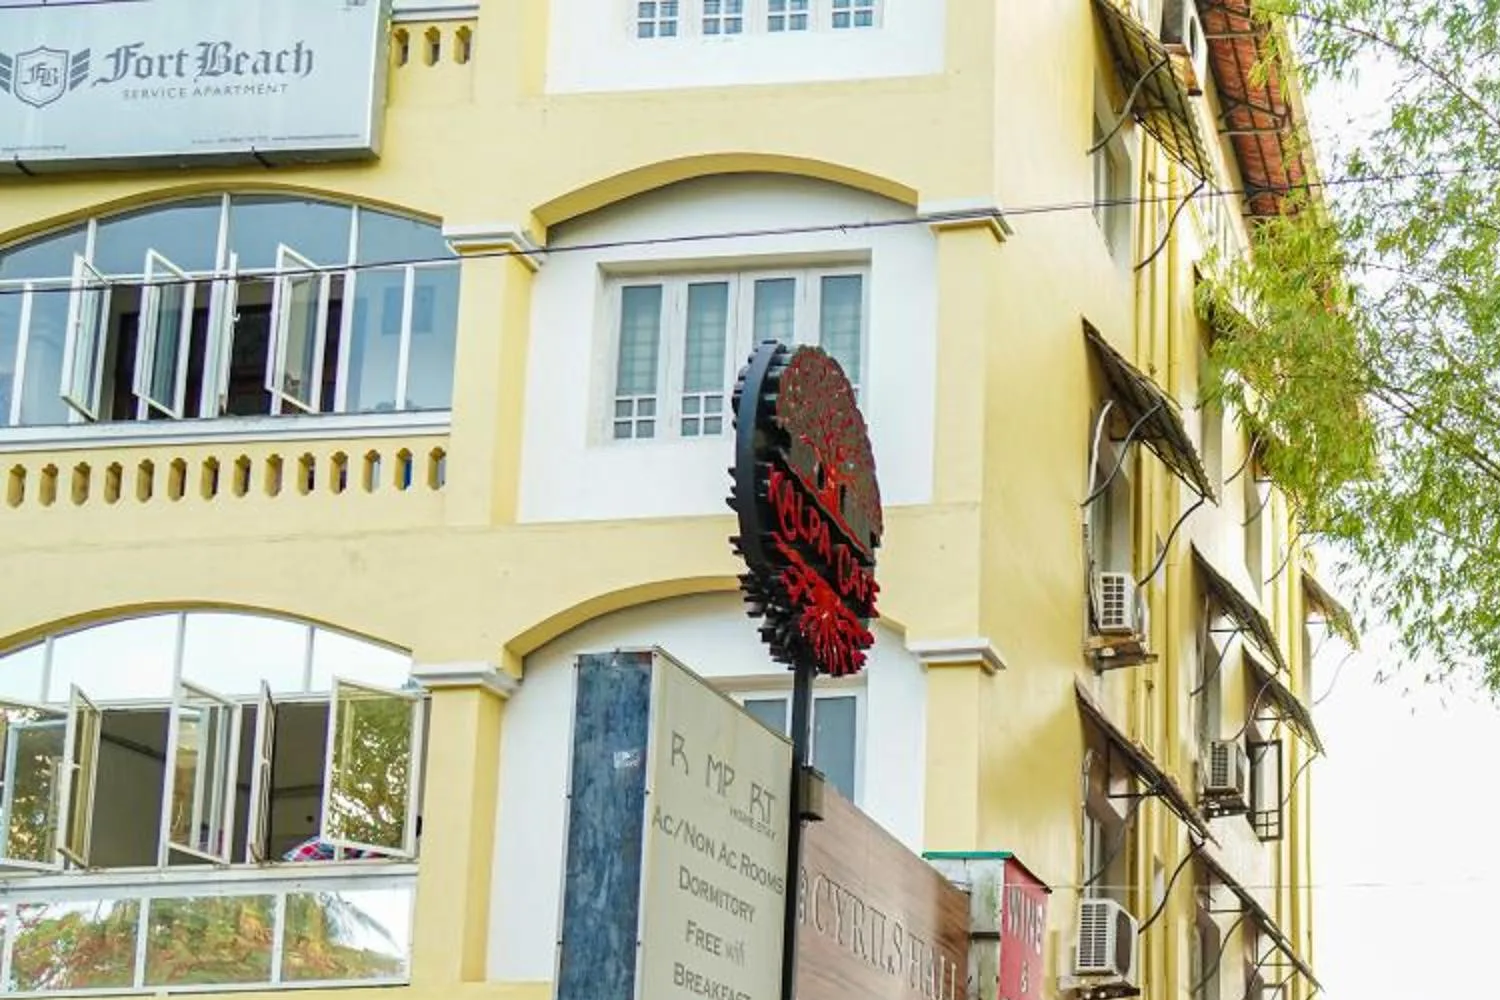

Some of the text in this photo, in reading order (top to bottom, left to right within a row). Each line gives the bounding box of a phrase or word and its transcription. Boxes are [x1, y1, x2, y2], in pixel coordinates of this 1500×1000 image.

[92, 40, 314, 87] Fort Beach
[122, 84, 288, 100] SERVICE APARTMENT
[679, 864, 756, 923] DORMITORY
[685, 919, 723, 957] FREE
